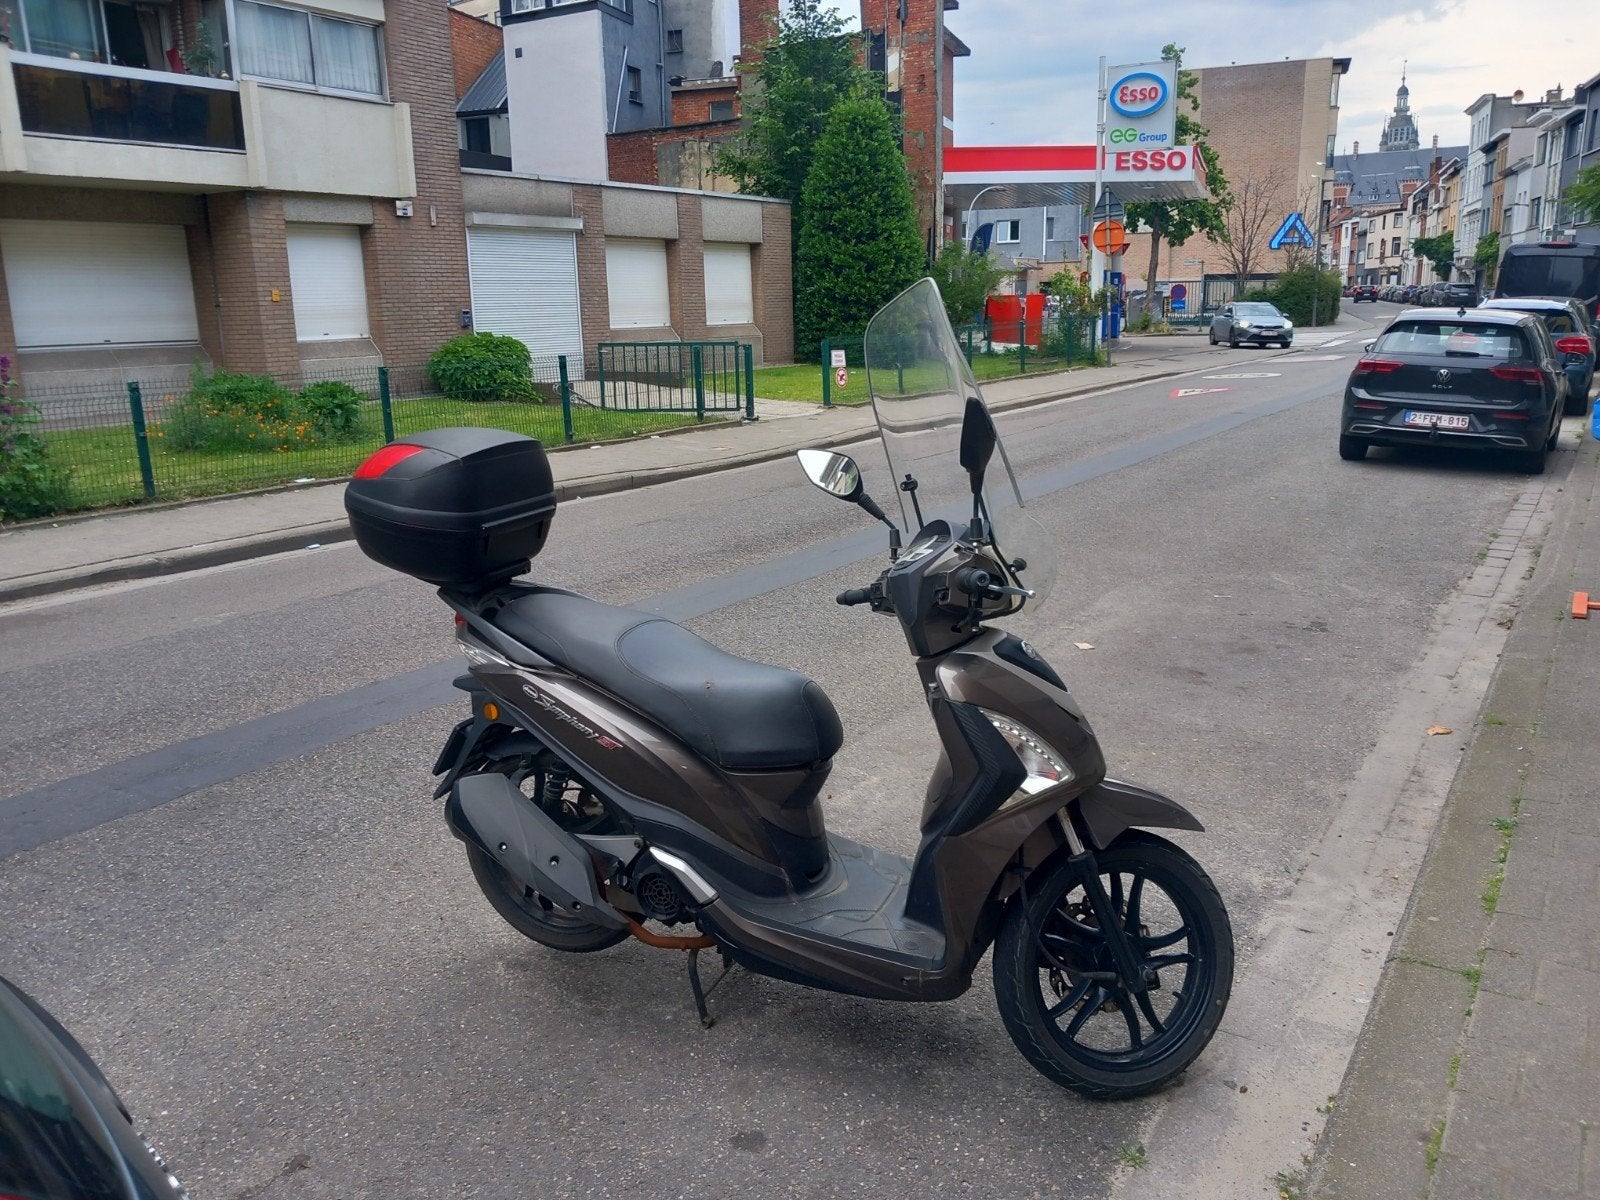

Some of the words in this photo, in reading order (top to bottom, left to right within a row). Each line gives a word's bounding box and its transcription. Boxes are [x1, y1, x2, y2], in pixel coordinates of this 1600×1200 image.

[1119, 85, 1159, 104] Esso
[1138, 130, 1168, 142] Group
[1115, 150, 1187, 171] ESSO
[597, 735, 624, 750] ST
